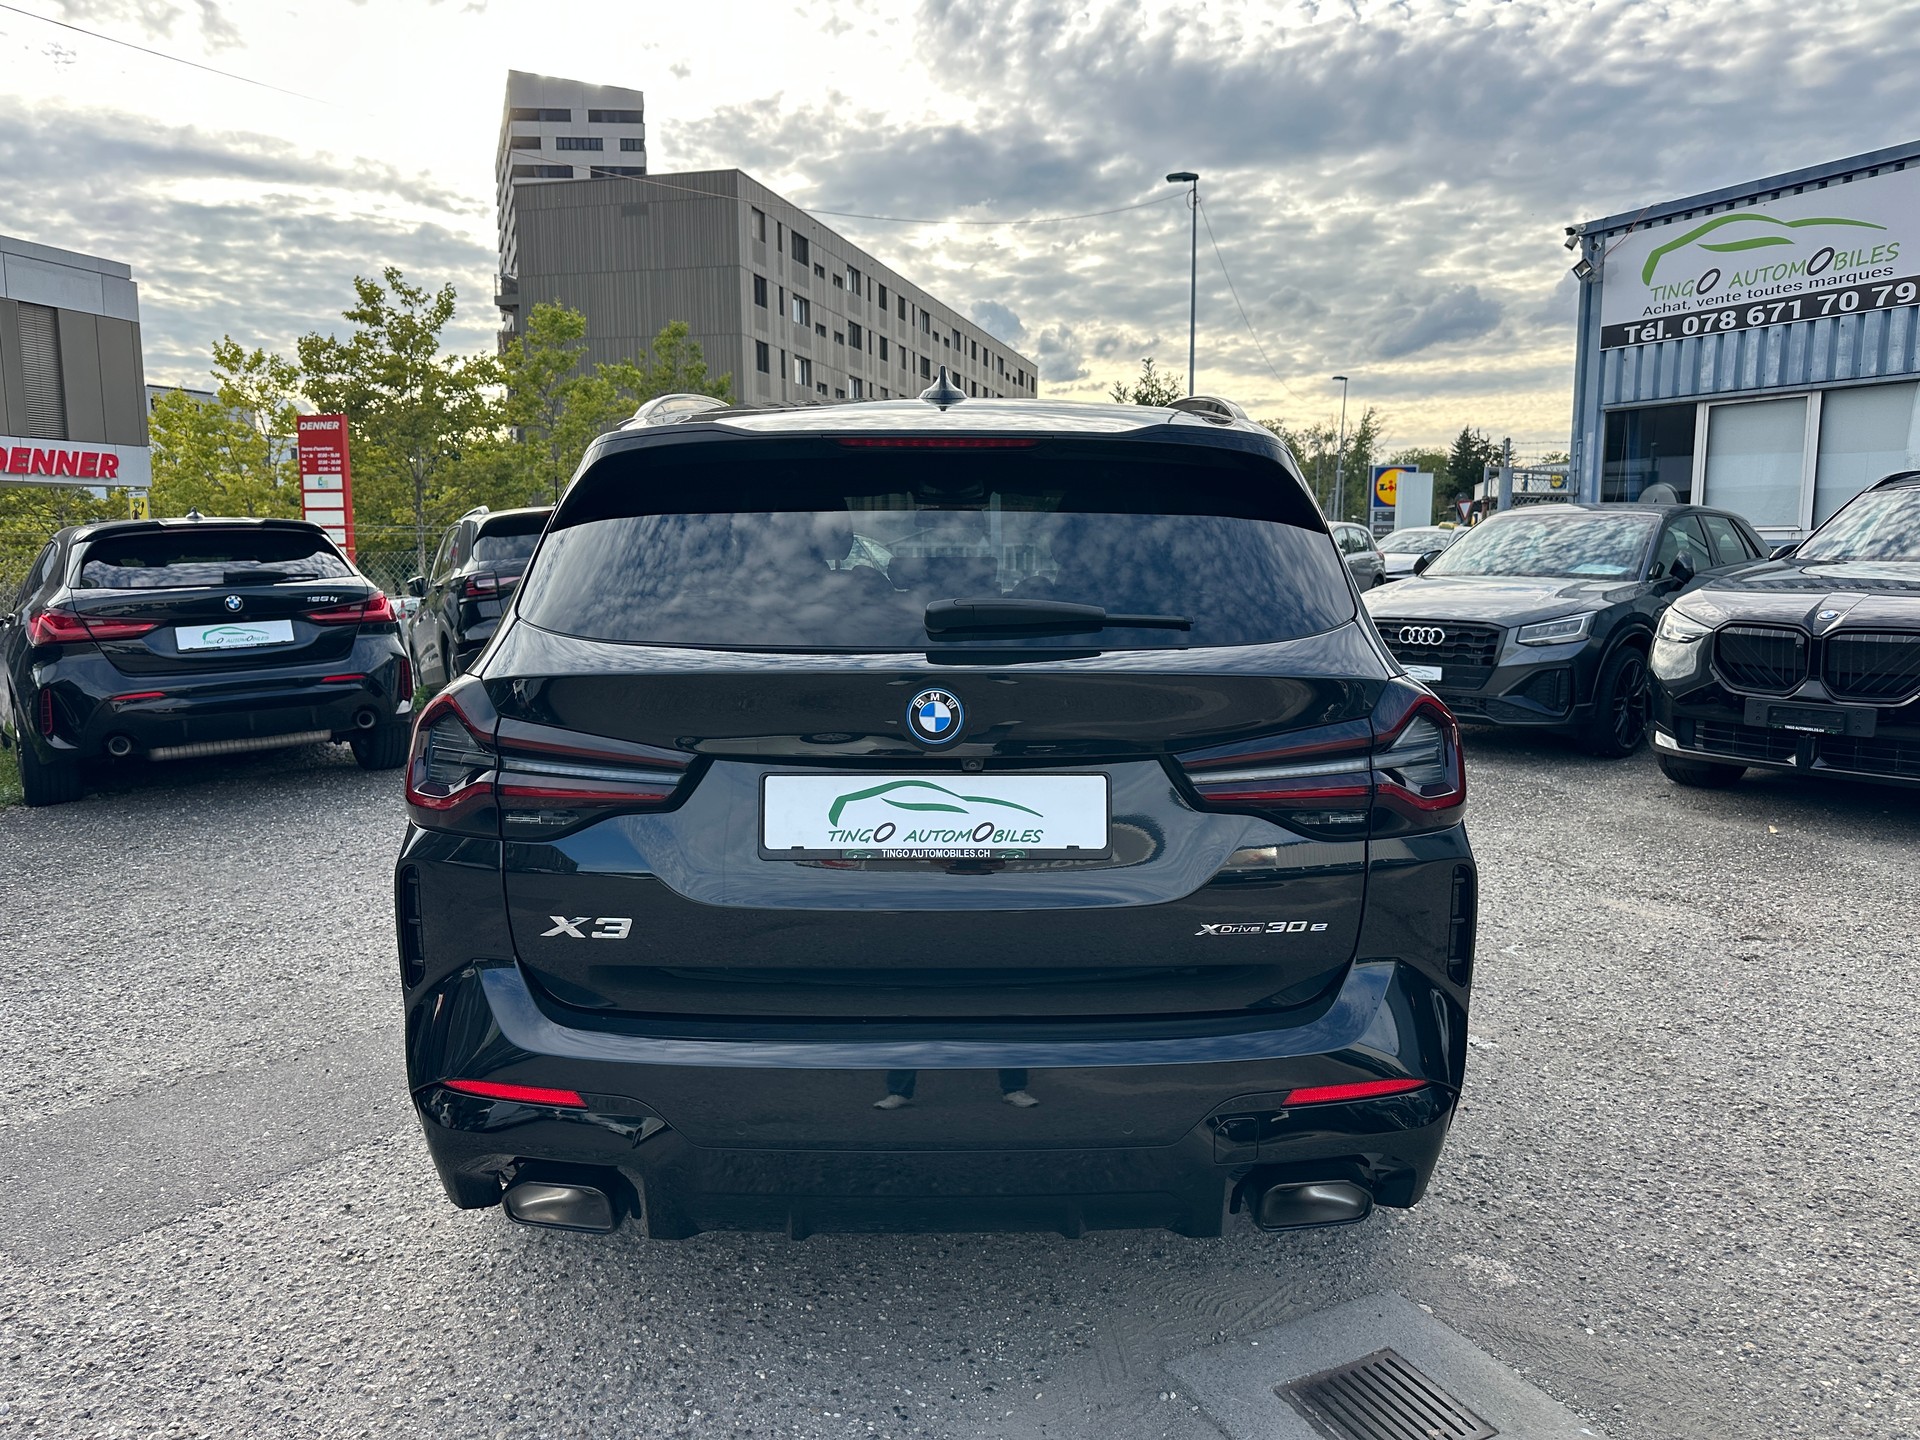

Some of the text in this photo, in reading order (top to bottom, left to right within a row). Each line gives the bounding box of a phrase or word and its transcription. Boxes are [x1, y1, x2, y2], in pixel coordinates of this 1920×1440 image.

[1650, 242, 1900, 302] TINGO AUTOMOBILES
[1642, 265, 1894, 317] Achat, vente toutes marques
[1623, 281, 1917, 344] Tél. 078 671 70 79
[300, 421, 340, 430] DENNER
[914, 692, 957, 709] BMW
[828, 822, 1044, 844] TINGO AUTOMOBILES
[882, 849, 991, 858] TINGO AUTOMOBILES.CH
[540, 915, 633, 939] X3
